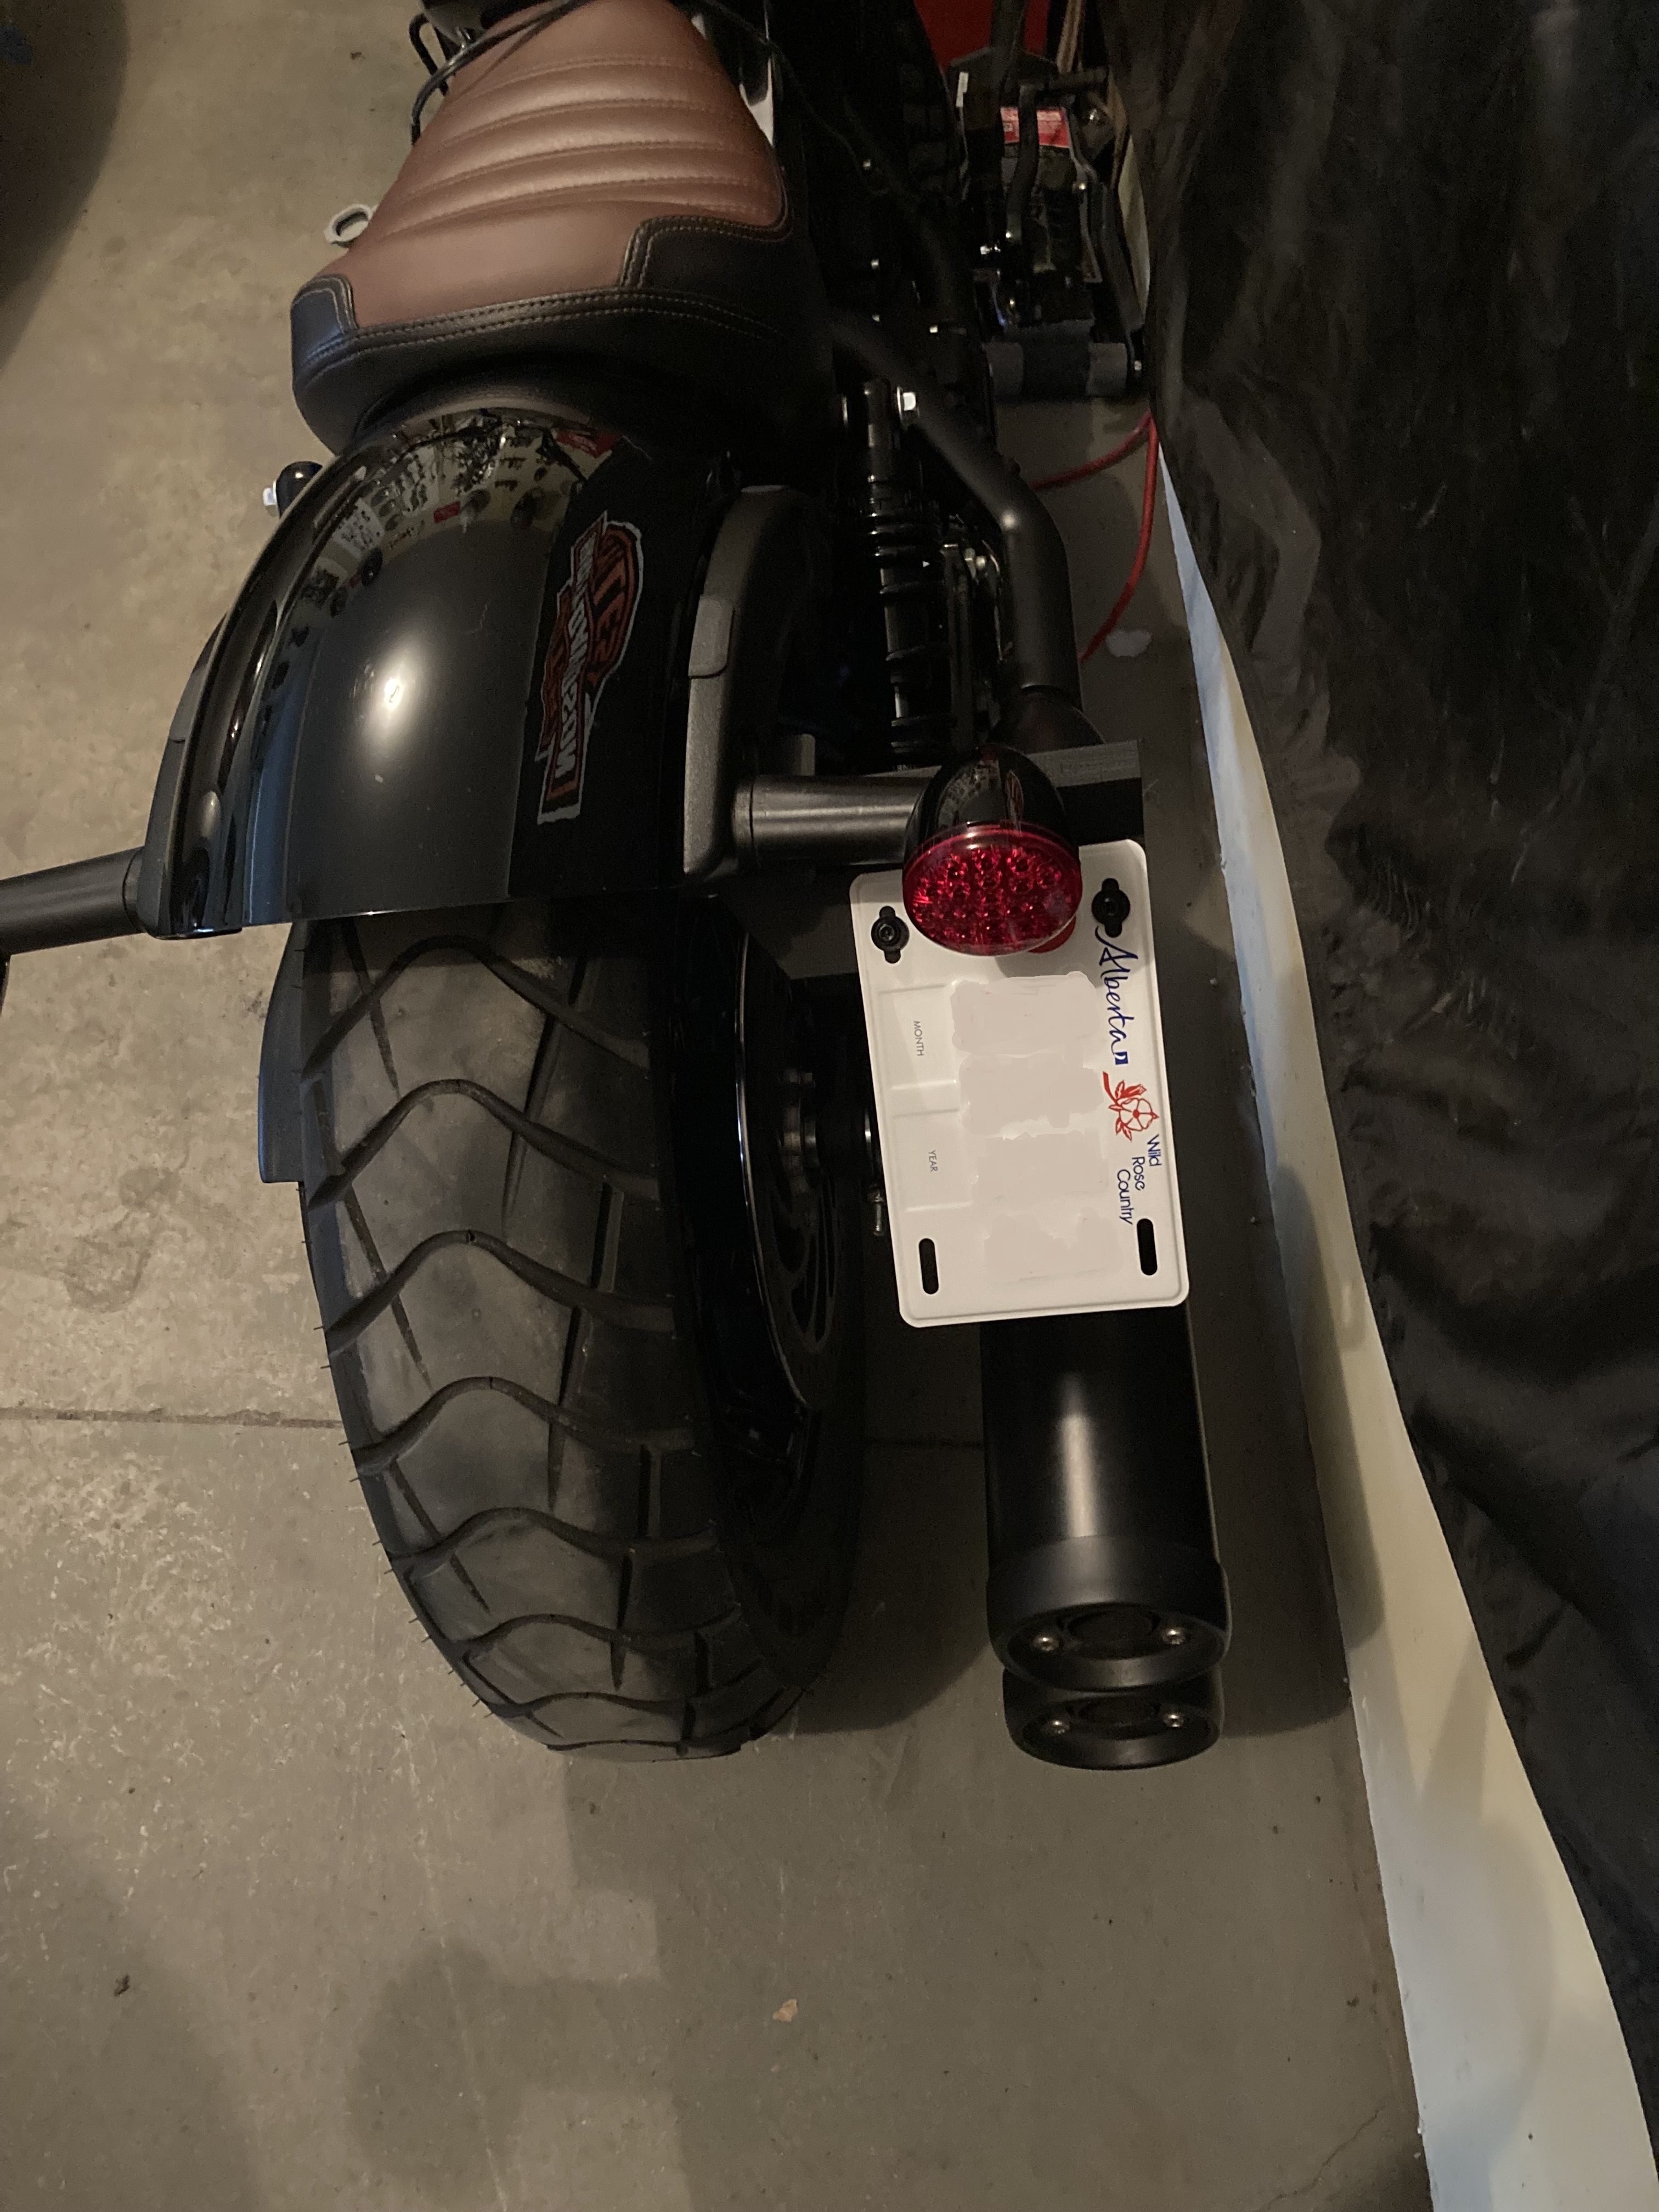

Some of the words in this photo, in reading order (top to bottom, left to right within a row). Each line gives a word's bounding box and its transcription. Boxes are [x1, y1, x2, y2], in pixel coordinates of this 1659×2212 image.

[1094, 925, 1138, 1054] Alberta
[913, 1020, 924, 1057] MONTH
[928, 1149, 938, 1172] YEAR
[1147, 1133, 1162, 1167] Wild
[1132, 1156, 1145, 1191] Rose
[1117, 1169, 1134, 1225] Country
